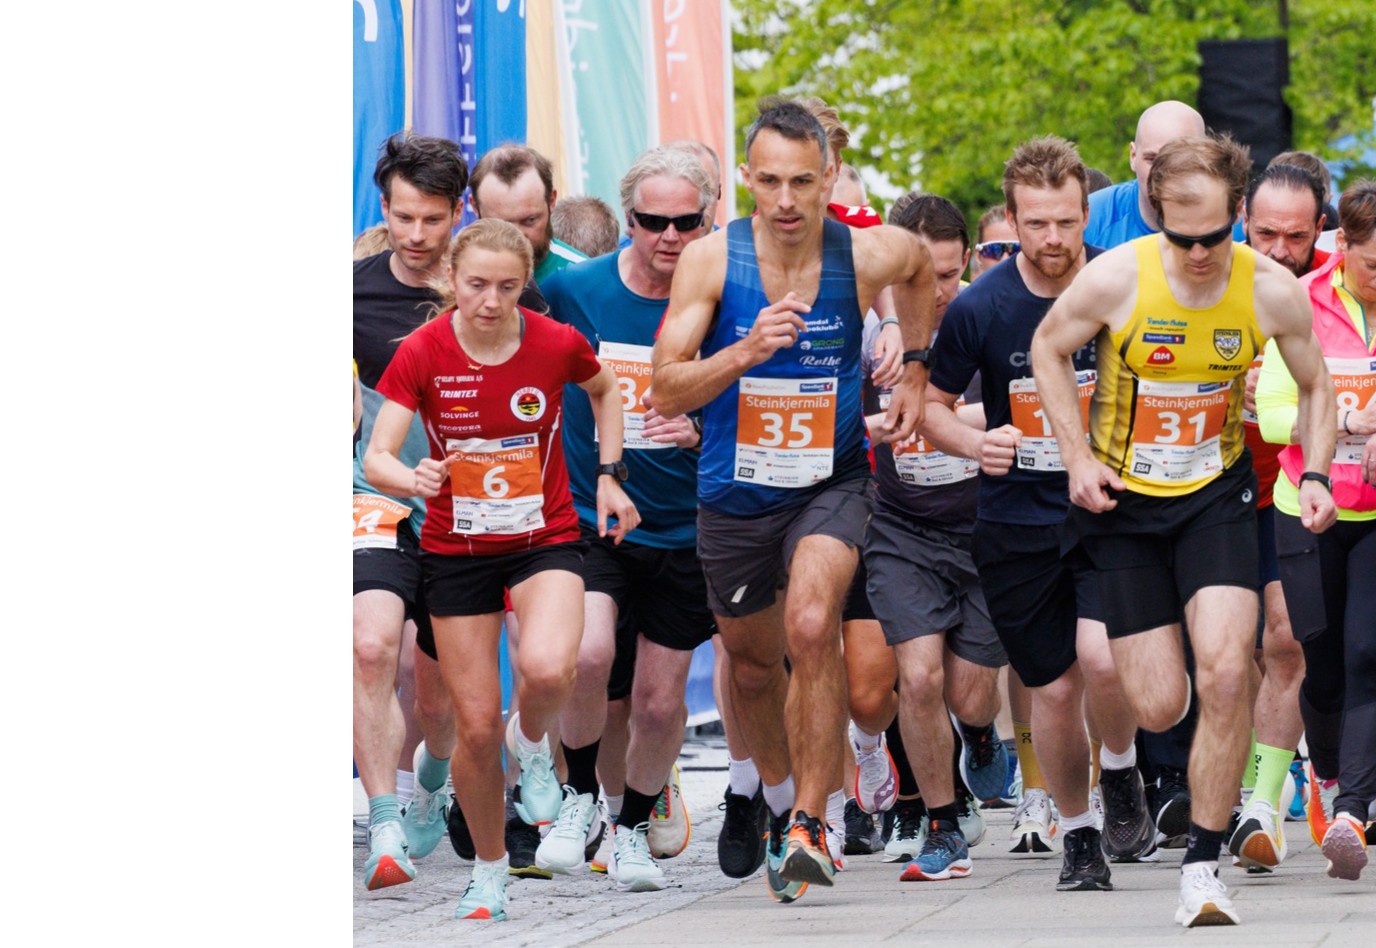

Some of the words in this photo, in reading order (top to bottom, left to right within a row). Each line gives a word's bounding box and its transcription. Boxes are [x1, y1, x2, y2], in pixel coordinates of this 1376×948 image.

[1153, 352, 1171, 360] BM
[440, 389, 478, 398] TRIMTEX
[746, 396, 830, 411] Steinkjermila
[1144, 394, 1224, 410] Steinkjermila
[757, 412, 814, 448] 35
[1154, 411, 1206, 444] 31
[455, 449, 534, 464] Steinkjermila
[739, 468, 754, 477] SSA
[1136, 463, 1149, 471] SSA
[483, 465, 509, 498] 6
